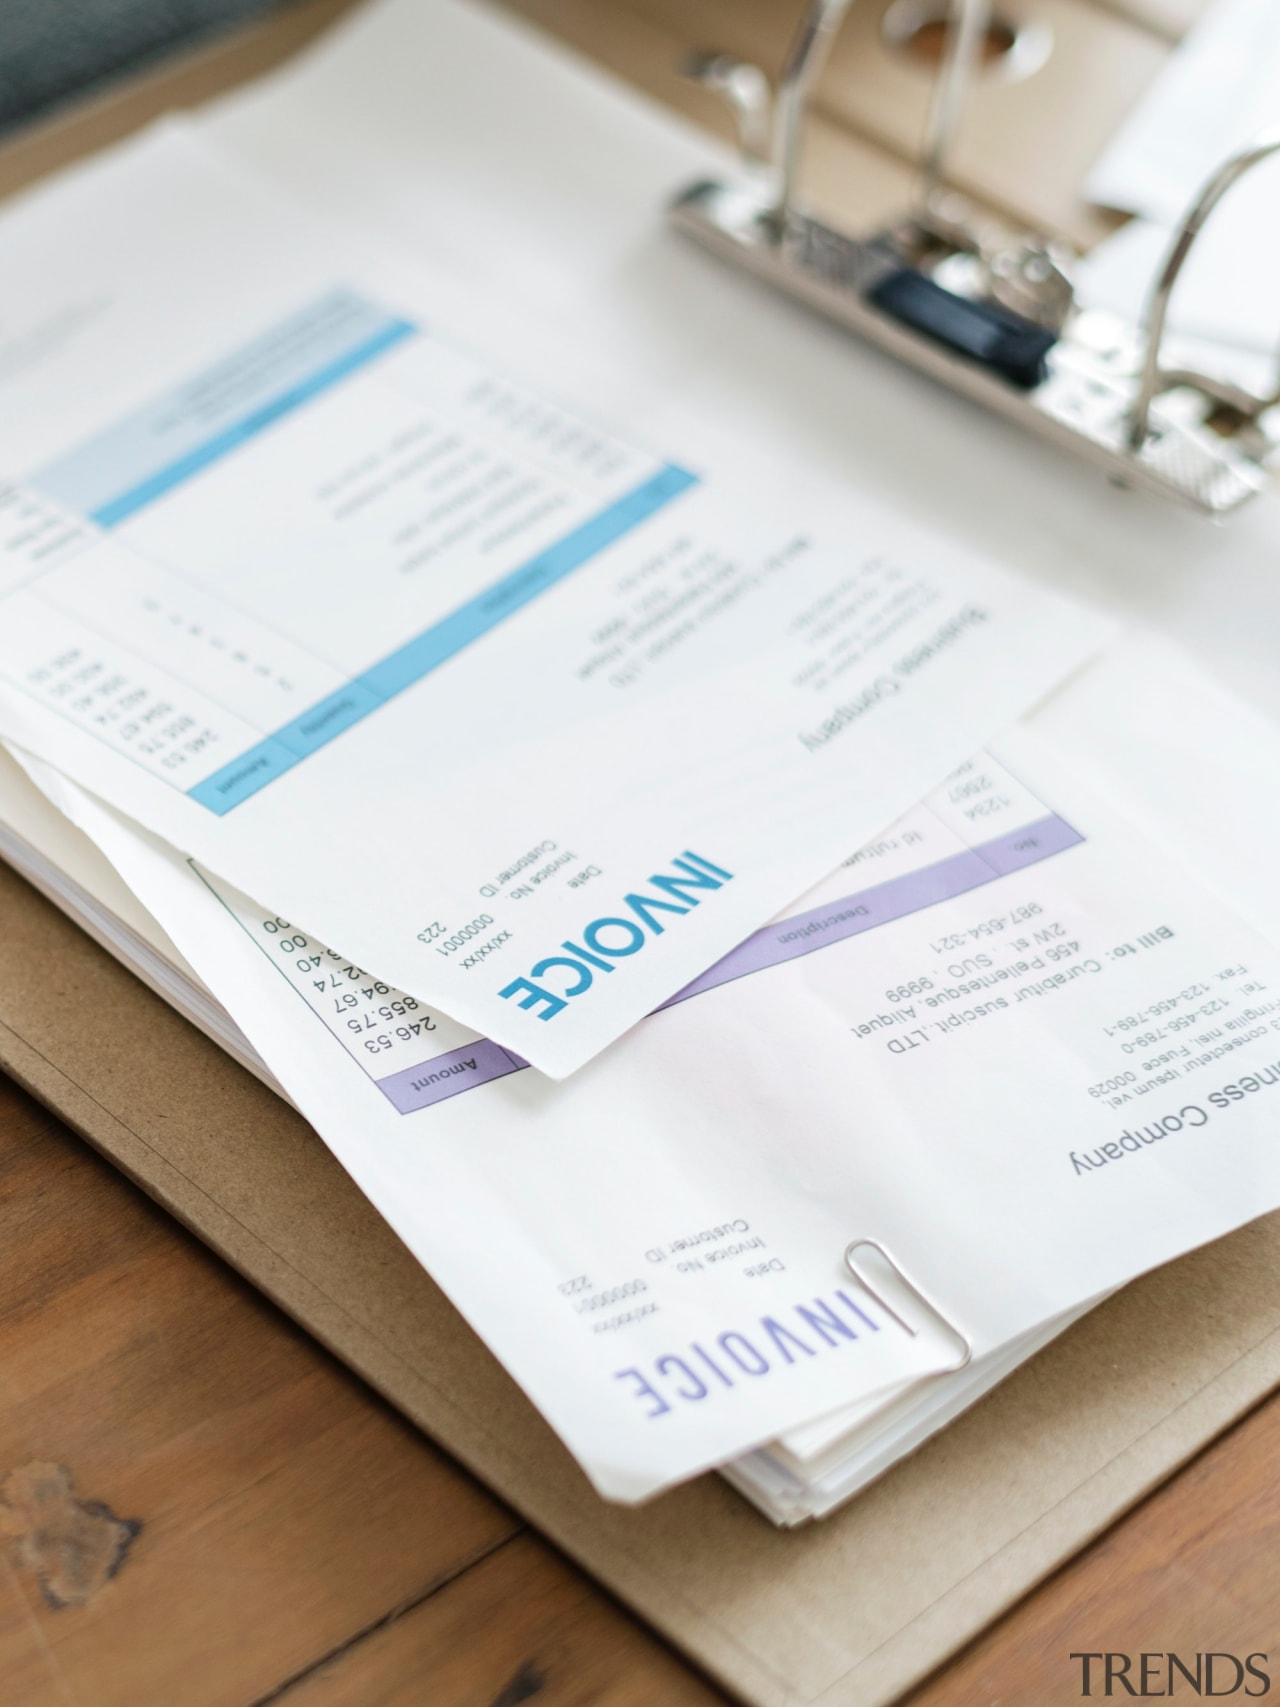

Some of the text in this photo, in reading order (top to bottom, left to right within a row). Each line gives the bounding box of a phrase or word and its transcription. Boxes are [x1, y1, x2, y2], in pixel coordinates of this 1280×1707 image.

[797, 674, 902, 752] Company
[479, 839, 557, 898] Customer ID
[530, 850, 577, 884] Invoice
[567, 865, 602, 888] Date
[417, 922, 447, 943] 223
[436, 914, 494, 956] 0000001
[497, 849, 734, 1022] INVOICE
[777, 904, 870, 945] Description
[928, 901, 1044, 956] 987-654-321
[1136, 924, 1177, 950] Bill
[459, 930, 513, 970] xx/xx/xx
[1045, 939, 1082, 963] 456
[1104, 943, 1137, 962] to:
[885, 976, 935, 1004] 9999
[1015, 958, 1103, 1003] Curabitur
[348, 996, 419, 1034] 855.75
[850, 1004, 918, 1040] Aliquet
[1103, 982, 1211, 1038] 123-456-789-1
[1120, 997, 1230, 1055] 123-456-789-0
[365, 1016, 436, 1054] 246.53
[1183, 1024, 1268, 1072] consectetur
[410, 1058, 479, 1092] Amount
[1141, 1045, 1192, 1072] Fusce
[1087, 1071, 1138, 1099] 00029
[1132, 1069, 1183, 1097] ipsum
[1069, 1104, 1209, 1177] Company
[644, 1218, 749, 1264] Customer ID
[705, 1236, 766, 1264] Invoice
[742, 1257, 786, 1278] Date
[613, 1289, 881, 1419] INVOICE
